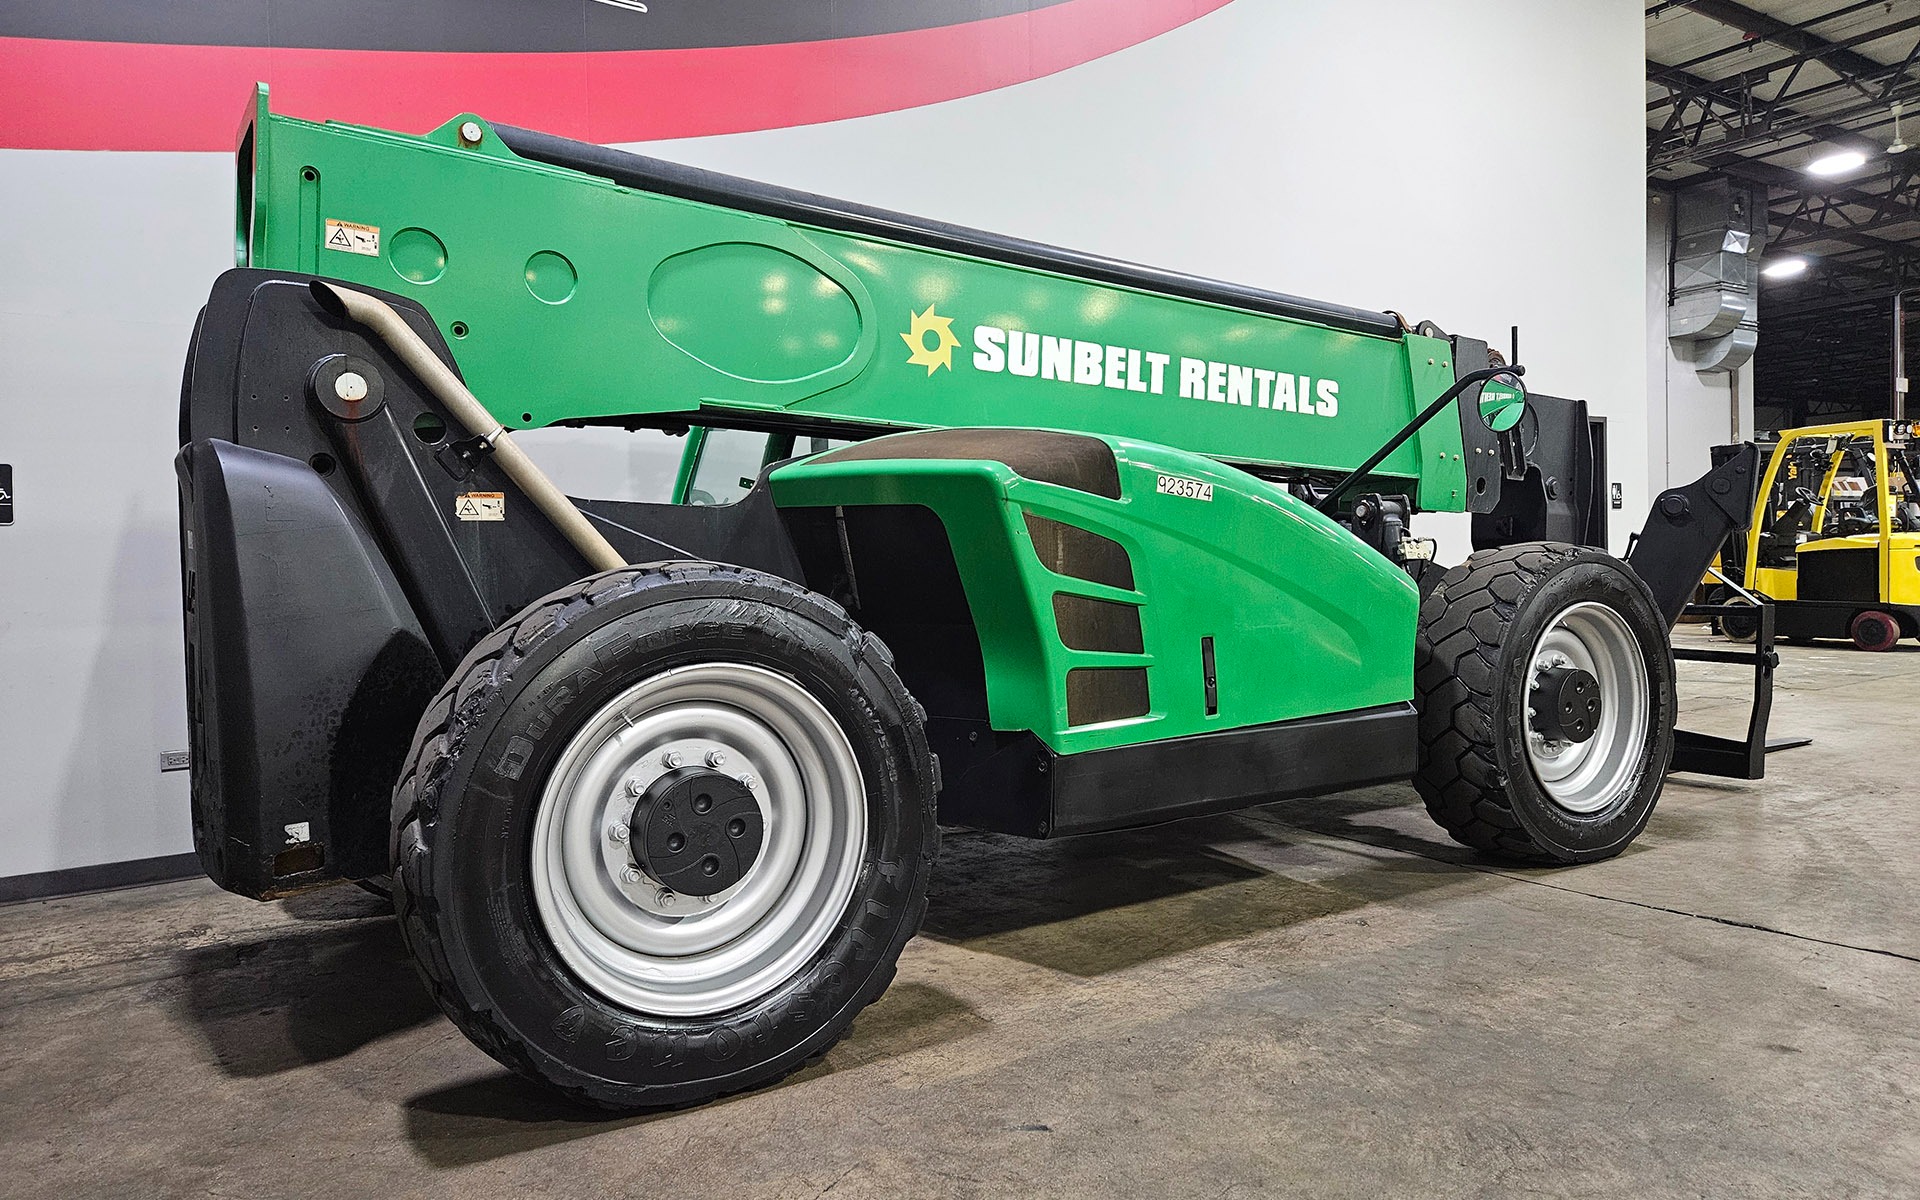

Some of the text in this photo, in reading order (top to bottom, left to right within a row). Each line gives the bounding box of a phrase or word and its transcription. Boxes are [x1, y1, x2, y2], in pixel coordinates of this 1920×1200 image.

[344, 222, 370, 231] WARNING
[972, 325, 1340, 418] SUNBELT RENTALS
[1158, 476, 1212, 500] 923574
